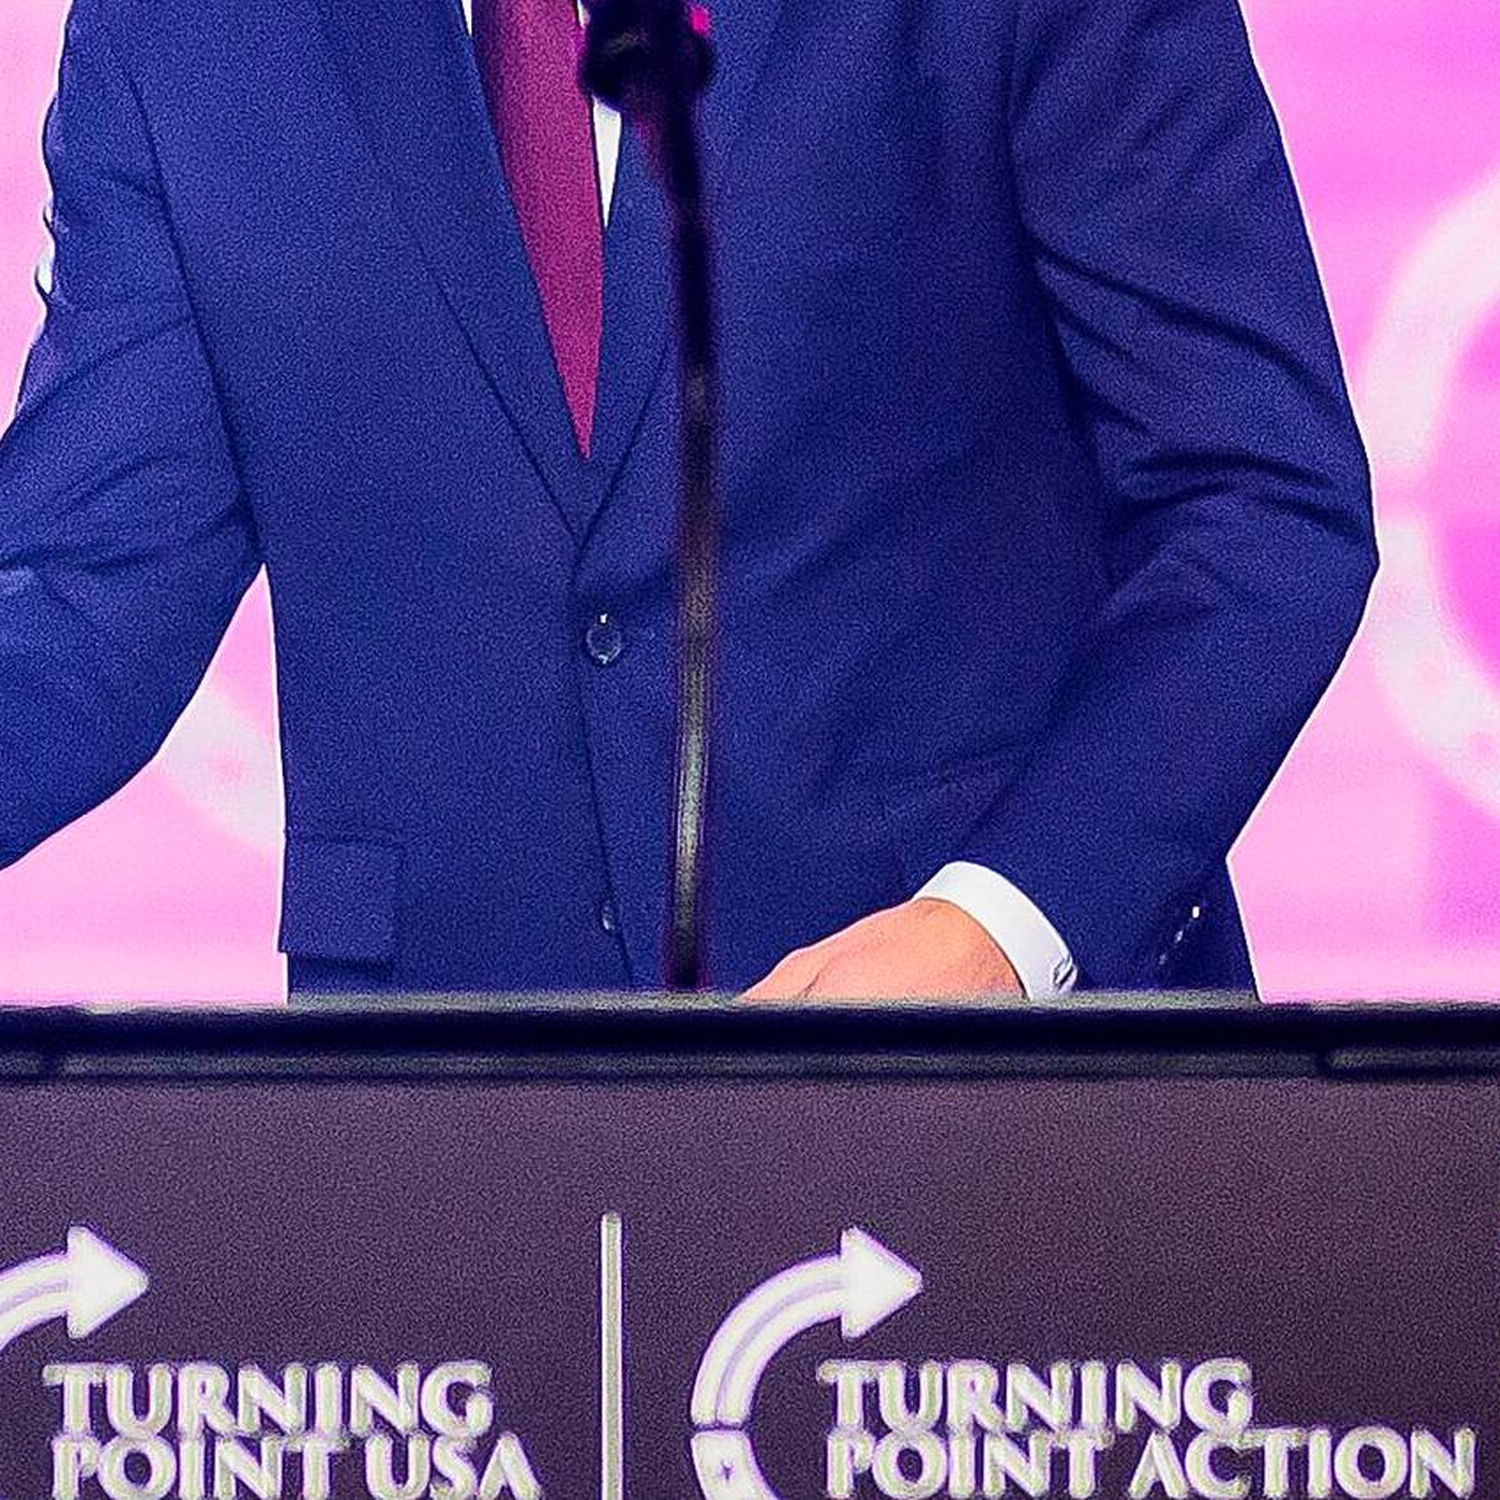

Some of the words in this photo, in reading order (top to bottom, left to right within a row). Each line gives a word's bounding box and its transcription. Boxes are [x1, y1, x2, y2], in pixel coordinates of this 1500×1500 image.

[41, 1361, 494, 1438] TURNING
[816, 1358, 1254, 1434] TURNING
[51, 1434, 345, 1500] POINT
[364, 1434, 541, 1500] USA
[826, 1430, 1114, 1500] POINT
[1127, 1426, 1476, 1500] ACTION
